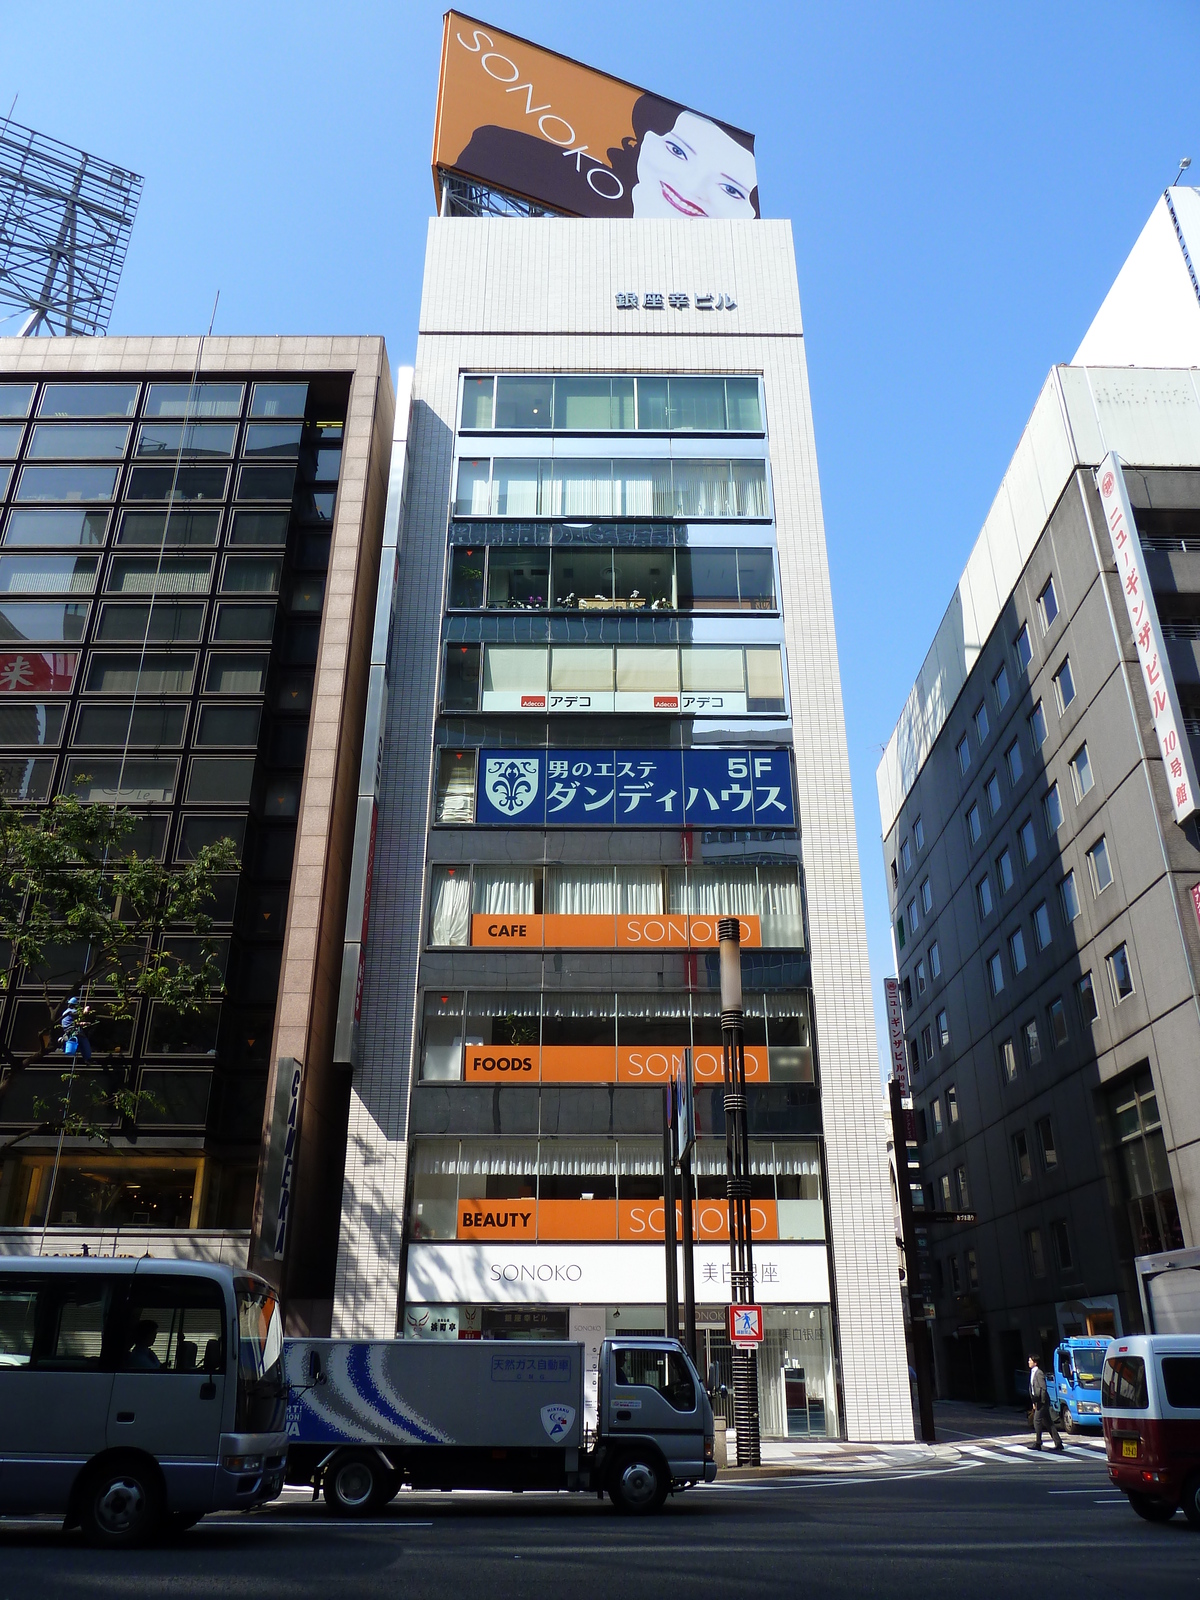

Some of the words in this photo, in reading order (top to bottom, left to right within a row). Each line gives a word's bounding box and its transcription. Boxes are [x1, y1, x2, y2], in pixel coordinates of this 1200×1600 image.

[457, 29, 625, 200] SONOKO
[615, 290, 738, 311] 銀座幸ビル
[550, 696, 591, 707] アデコ
[683, 697, 723, 708] アデコ
[548, 760, 657, 778] 男のエステ
[727, 758, 772, 778] 5F
[546, 781, 787, 813] ダンディハウス
[487, 924, 527, 937] CAFE
[473, 1057, 532, 1071] FOODS
[462, 1212, 532, 1227] BEAUTY
[490, 1263, 582, 1282] SONOKO
[493, 1359, 568, 1371] 天然ガス自動車
